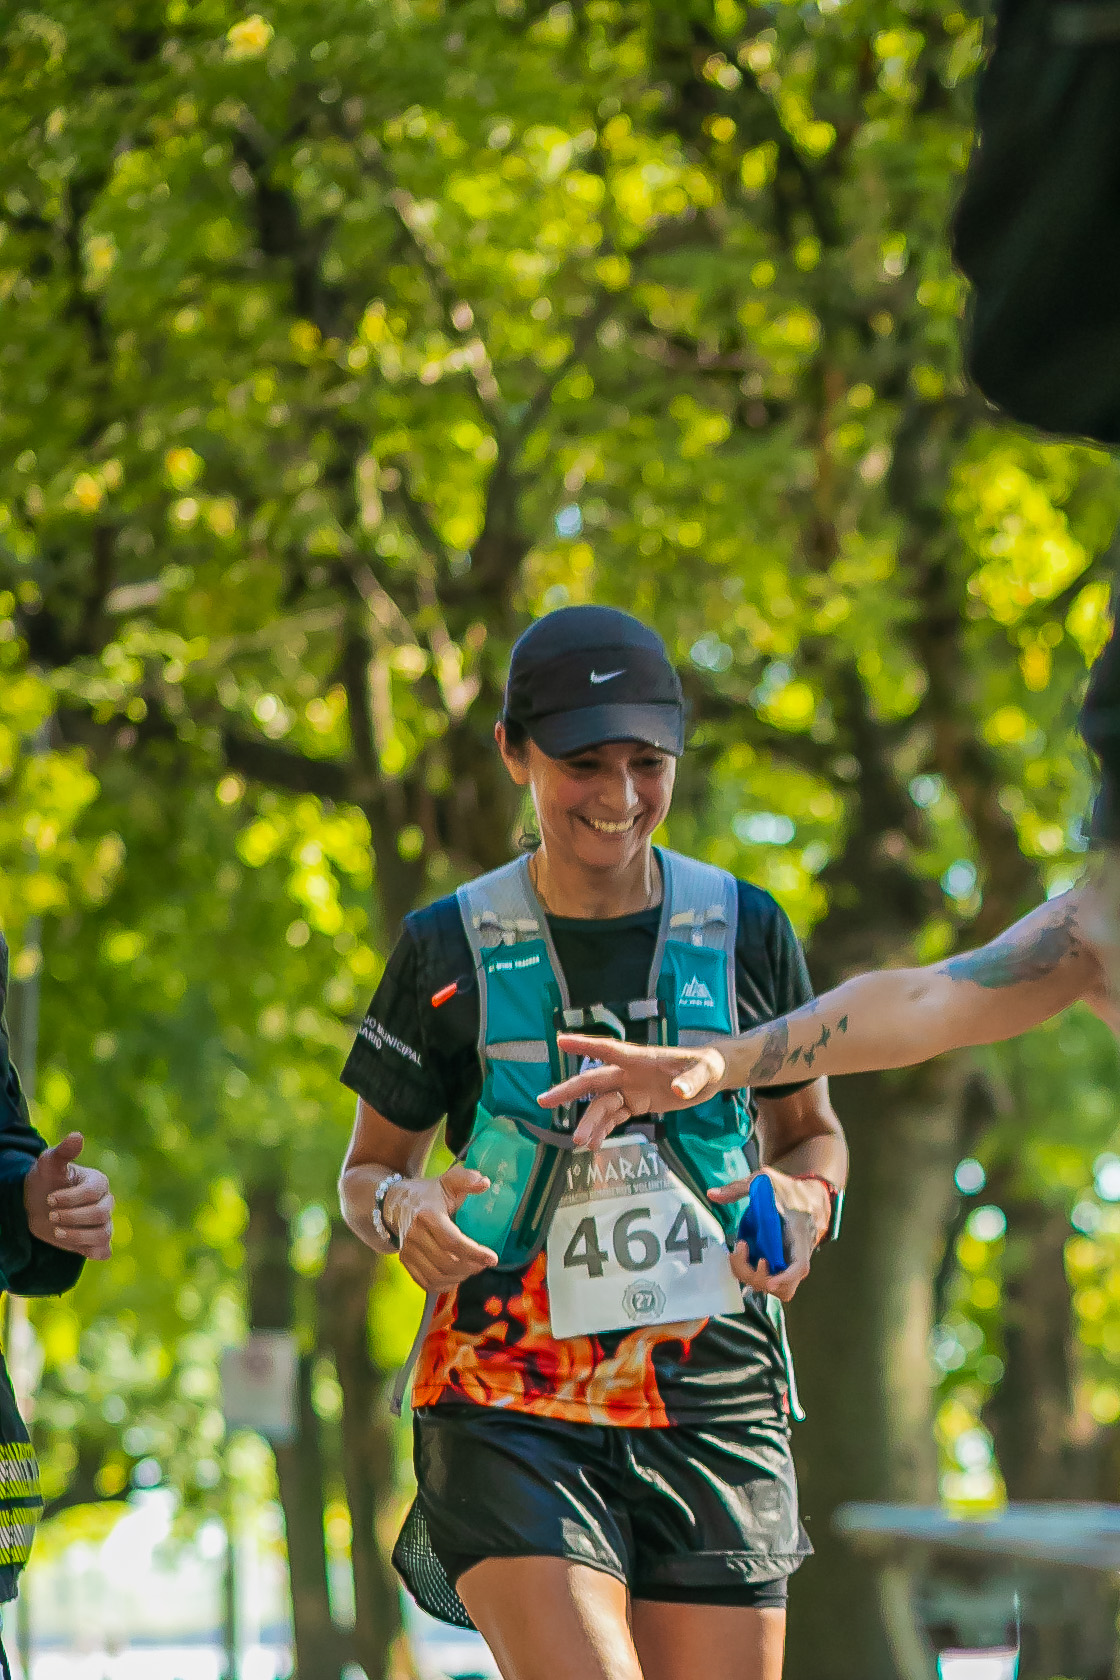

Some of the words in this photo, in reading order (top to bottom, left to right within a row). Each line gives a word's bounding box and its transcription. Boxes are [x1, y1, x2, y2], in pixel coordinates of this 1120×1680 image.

[359, 1026, 382, 1050] ARIO
[376, 1022, 422, 1067] MUNICIPAL
[587, 1152, 660, 1186] MARAT
[564, 1203, 708, 1279] 464
